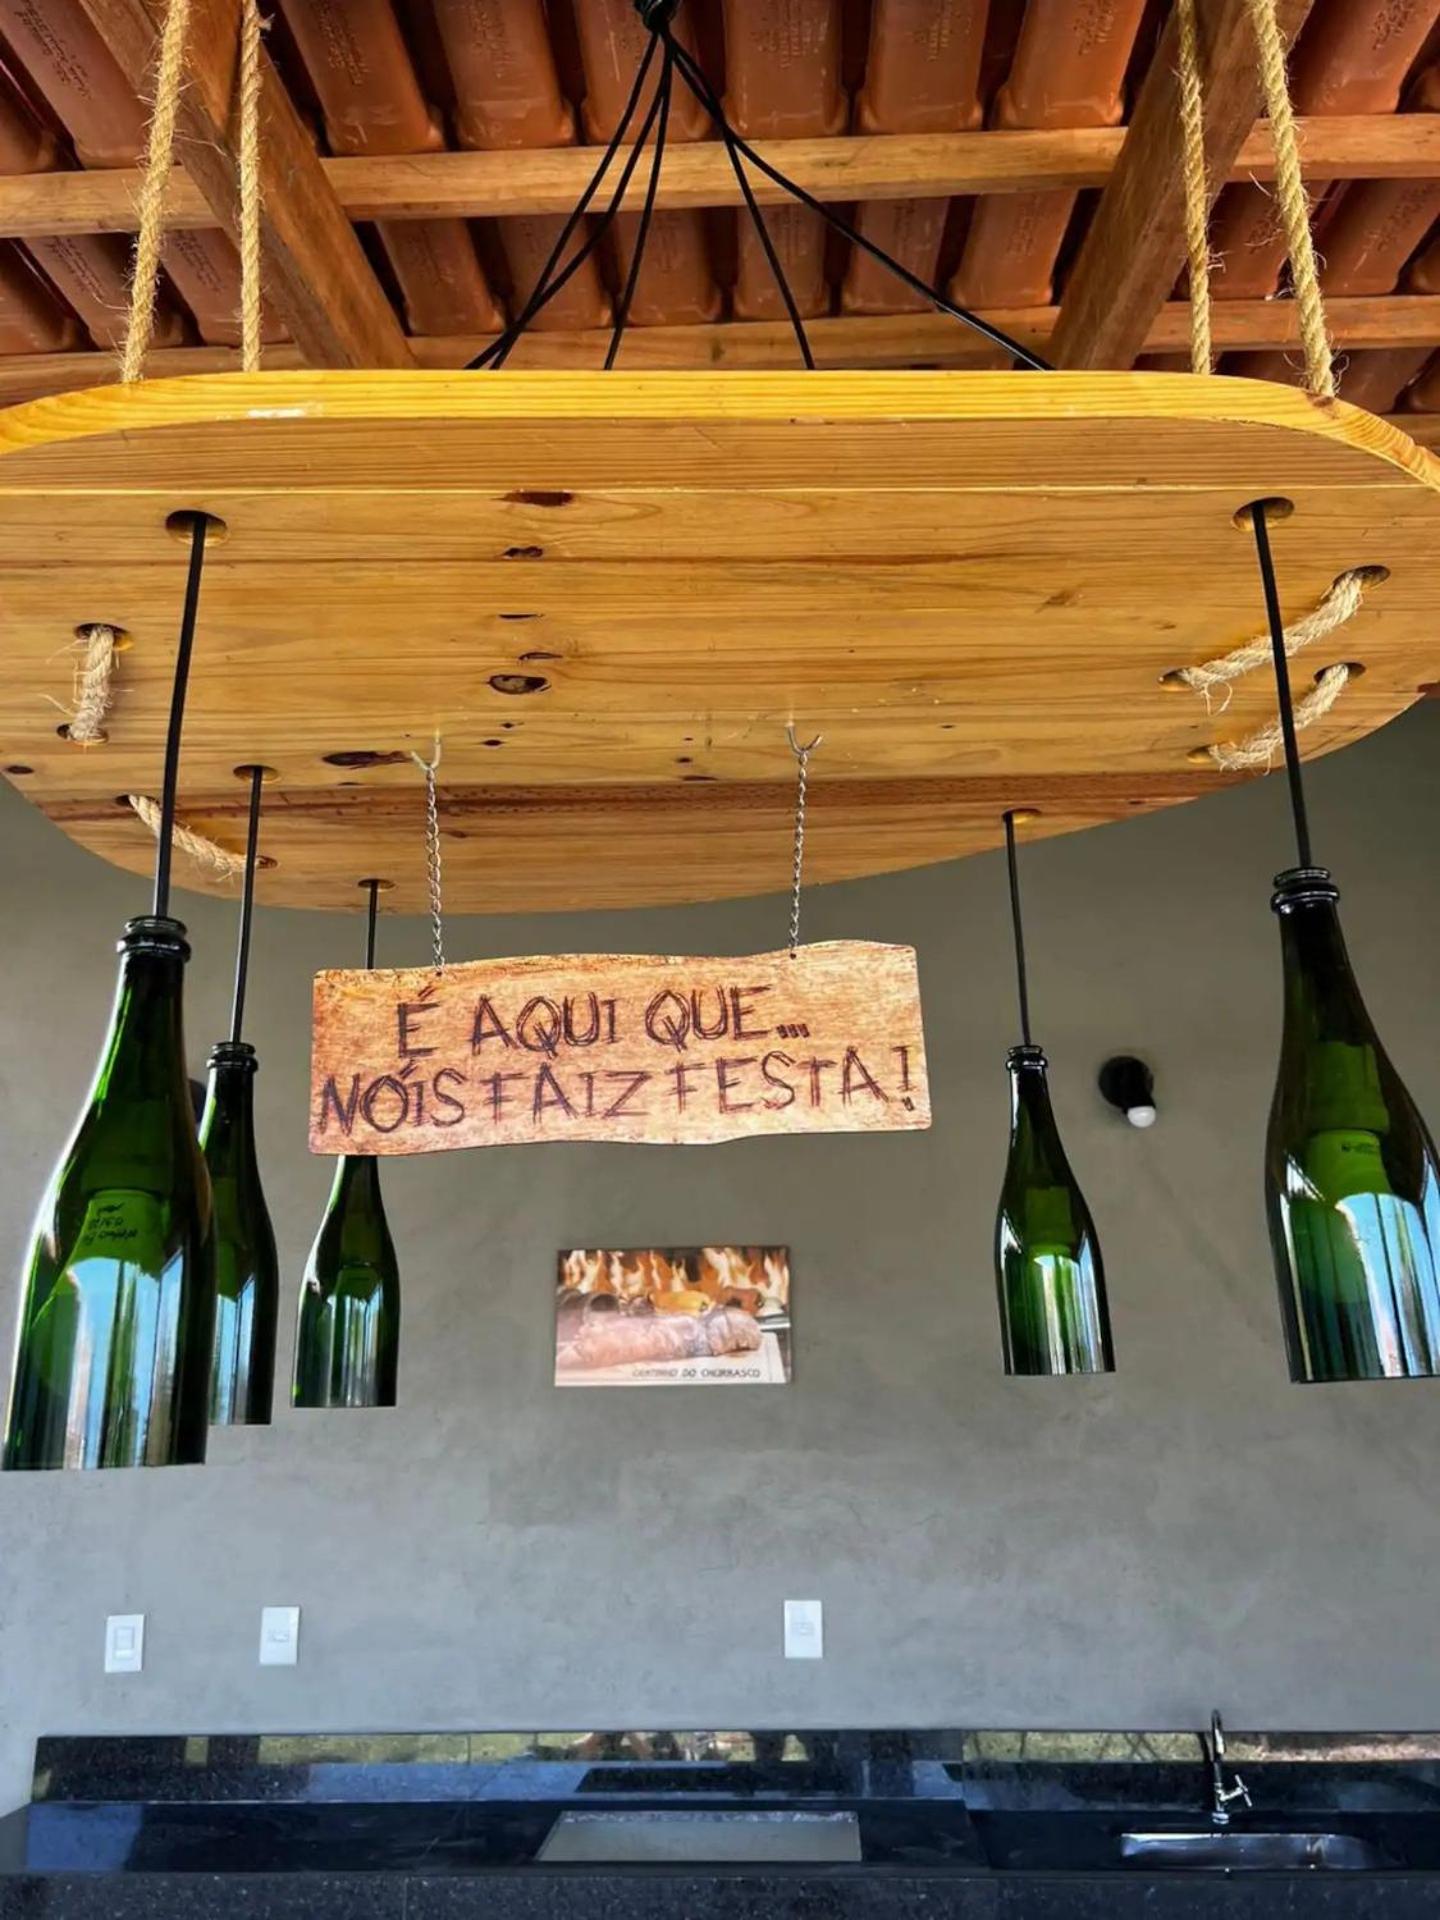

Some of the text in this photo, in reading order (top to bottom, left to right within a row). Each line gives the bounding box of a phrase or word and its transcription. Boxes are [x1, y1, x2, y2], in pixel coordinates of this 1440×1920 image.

[397, 984, 810, 1060] É AQUI QUE...
[316, 1045, 915, 1137] NÓIS FAIZ FESTA!
